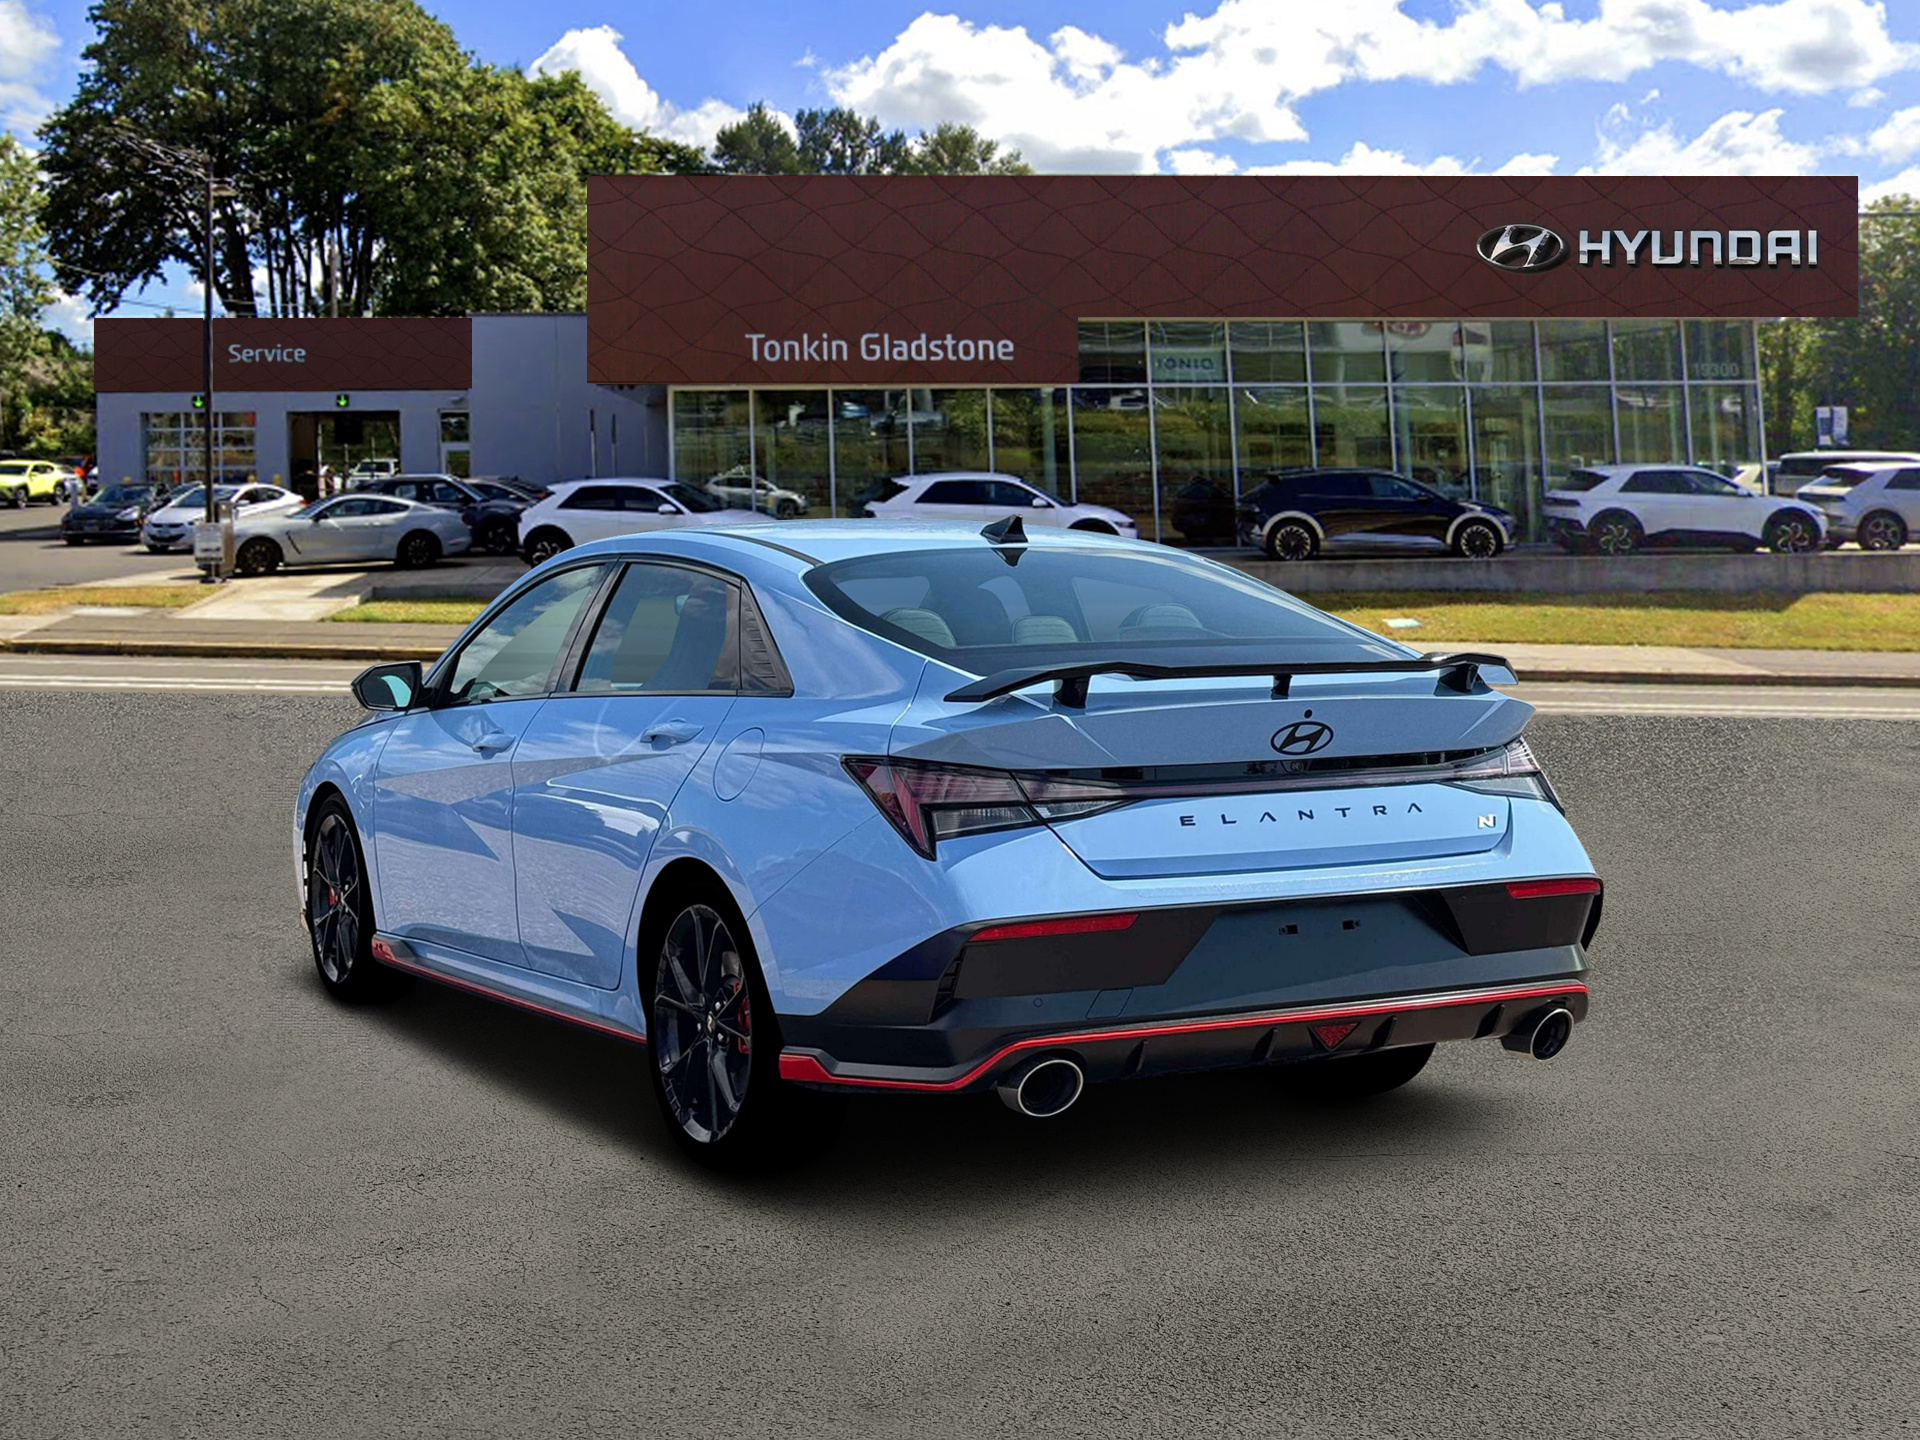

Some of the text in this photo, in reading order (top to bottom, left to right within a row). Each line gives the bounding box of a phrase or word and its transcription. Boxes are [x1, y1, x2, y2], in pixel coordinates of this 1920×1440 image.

[1578, 229, 1818, 265] HYUNDAI
[228, 343, 307, 363] Service
[744, 332, 1015, 363] Tonkin Gladstone
[1156, 357, 1215, 370] IONIQ
[1179, 802, 1497, 829] ELANTRA N
